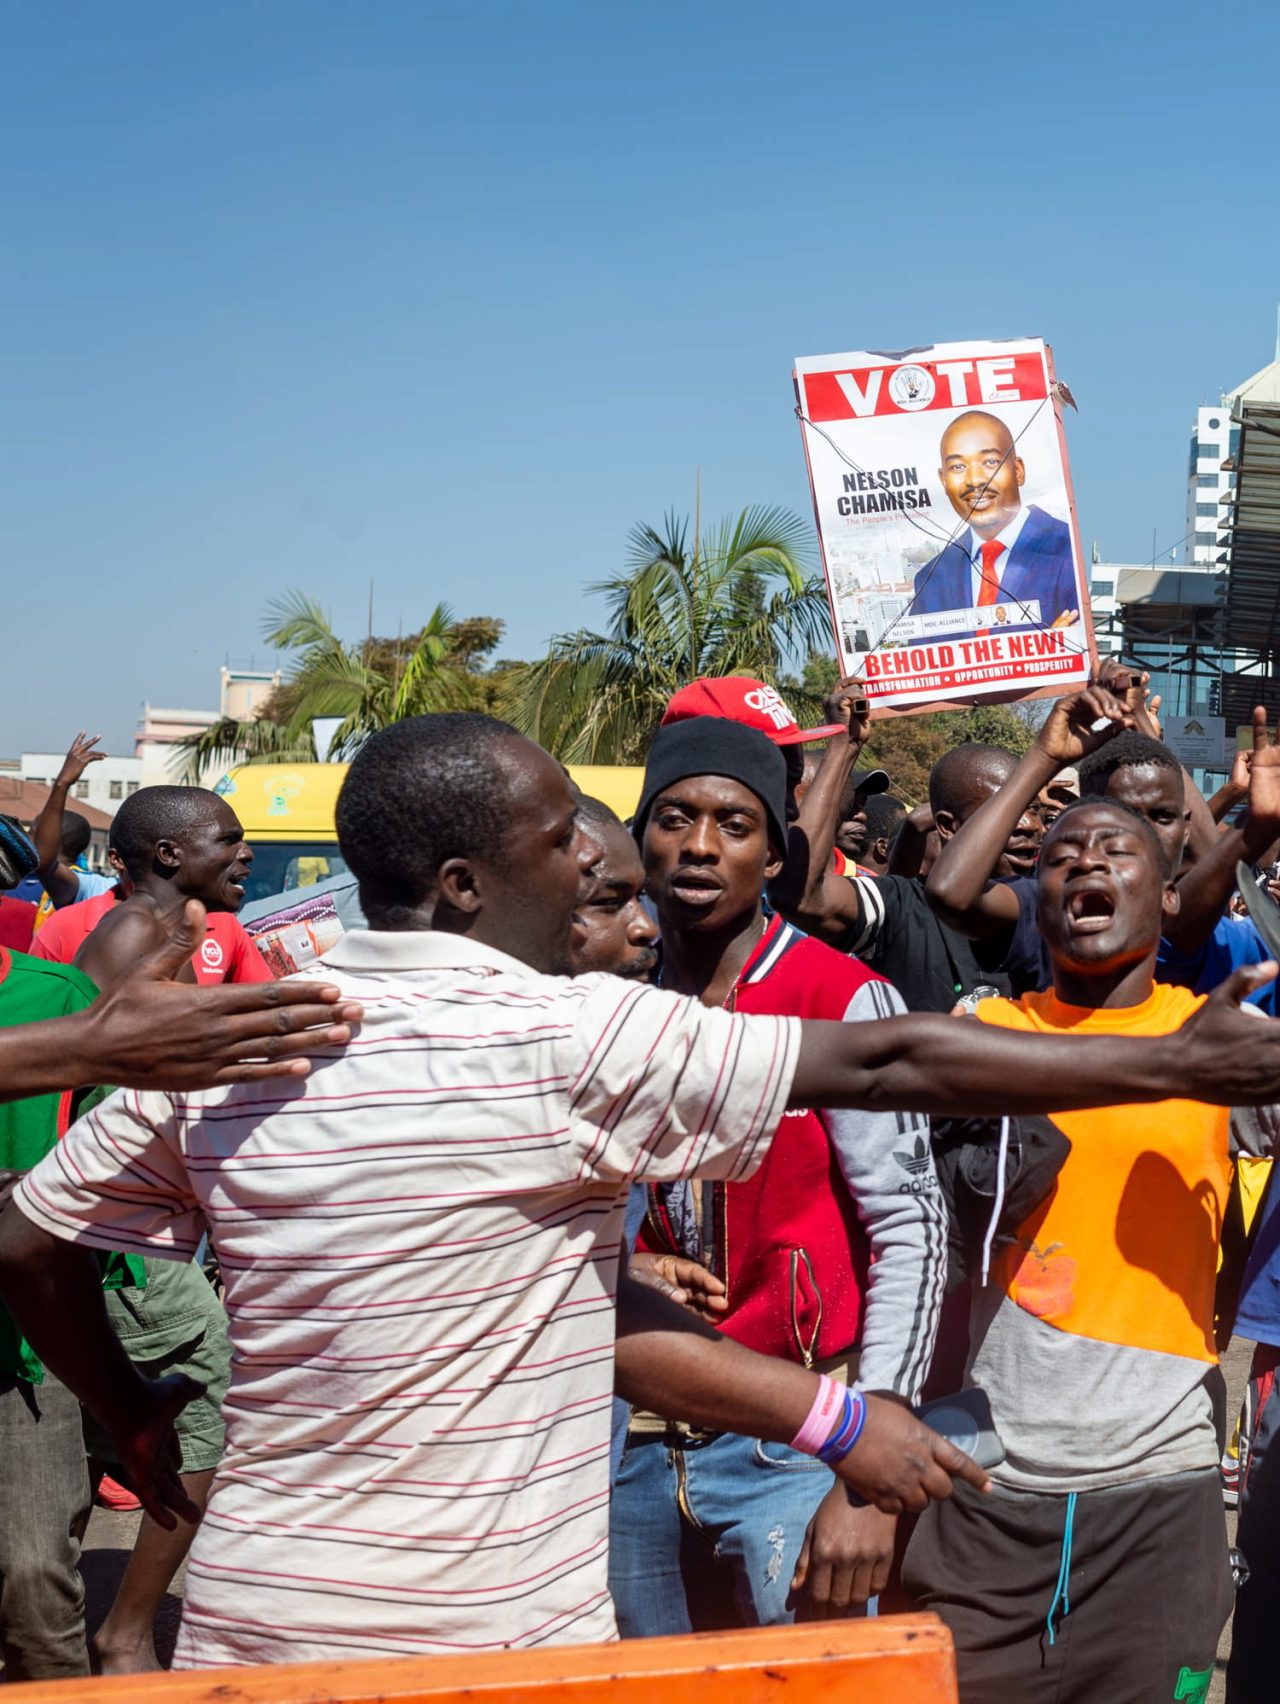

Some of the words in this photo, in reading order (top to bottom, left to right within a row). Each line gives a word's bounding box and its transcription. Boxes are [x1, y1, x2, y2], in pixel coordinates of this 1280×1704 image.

[834, 357, 1021, 417] VOTE
[842, 467, 919, 492] NELSON
[837, 488, 932, 516] CHAMISA
[846, 518, 861, 526] The
[862, 514, 893, 523] People's
[895, 511, 930, 522] President
[864, 645, 954, 677] BEHOLD
[958, 638, 1004, 665] THE
[1007, 631, 1066, 659] NEW!
[862, 675, 942, 695] TRANSFORMATION
[954, 665, 1014, 683] OPPORTUNITY
[1023, 658, 1074, 674] PROSPERITY
